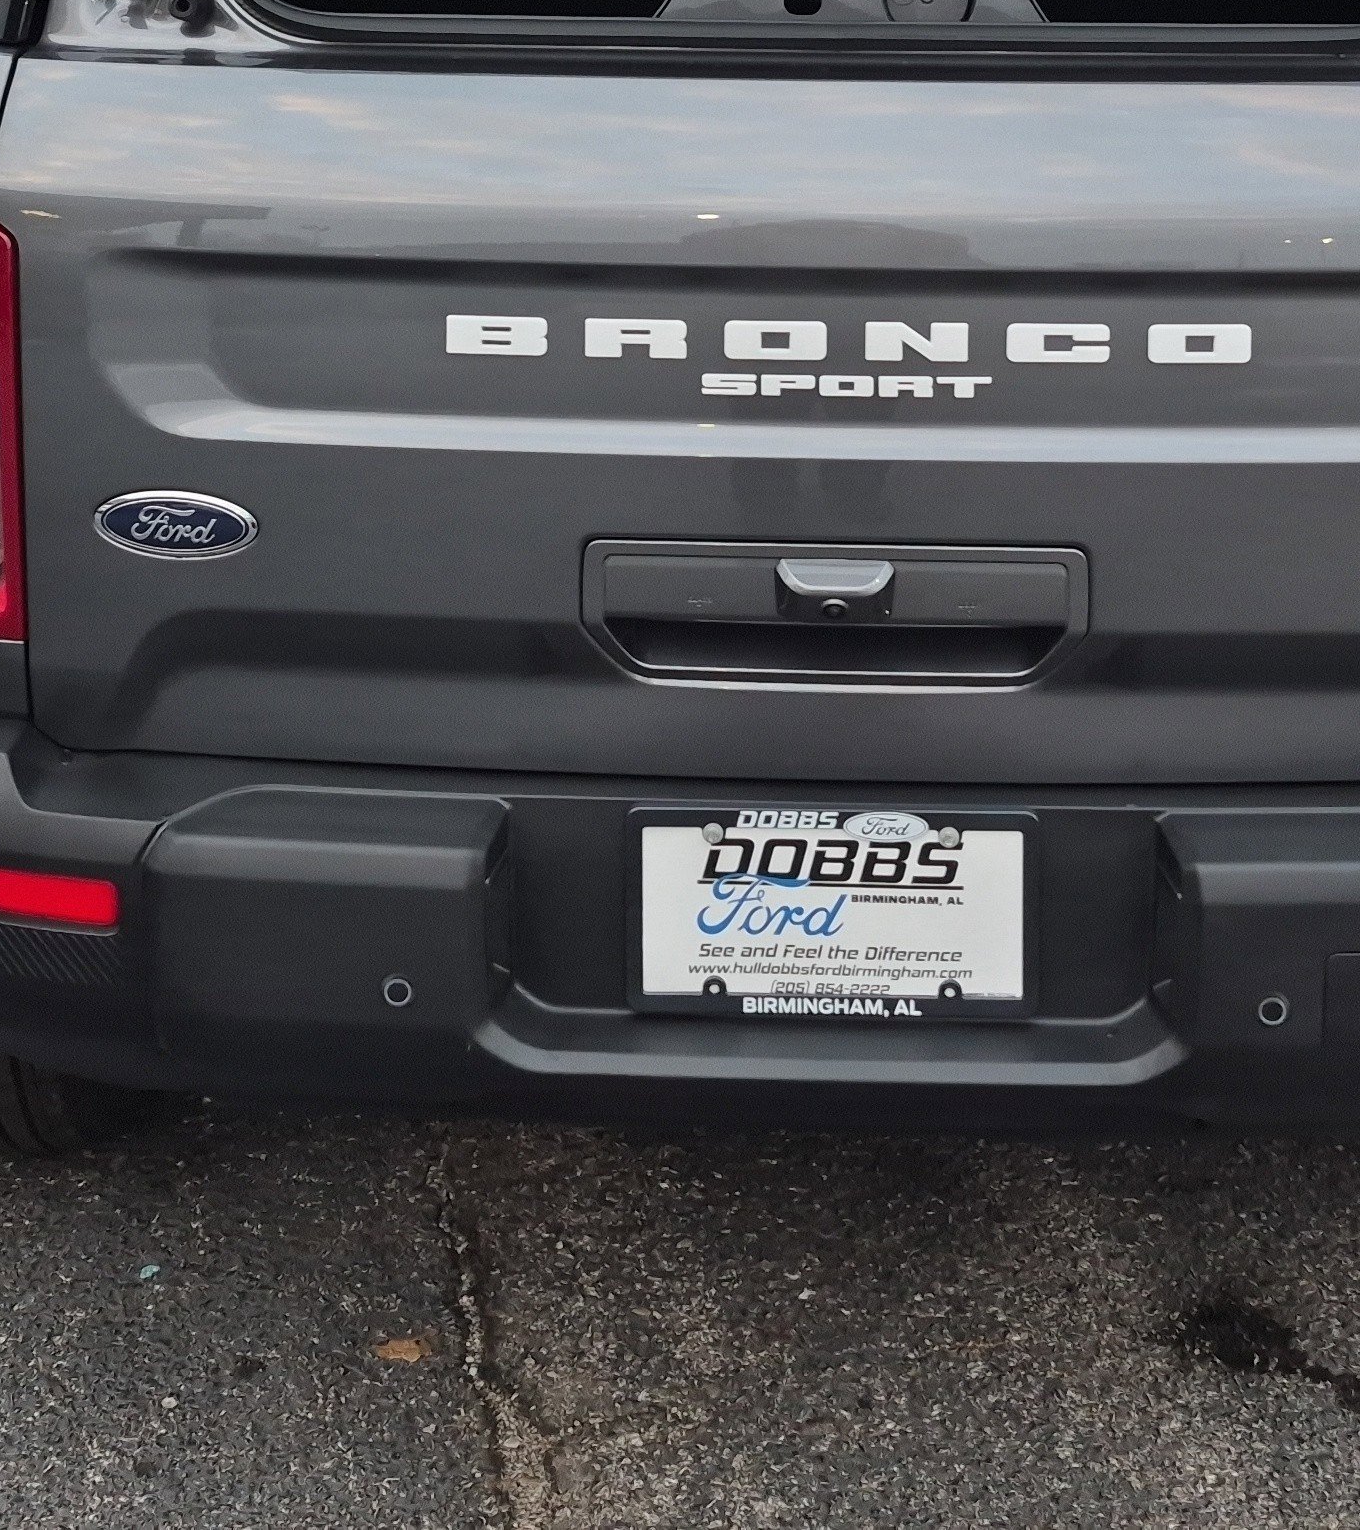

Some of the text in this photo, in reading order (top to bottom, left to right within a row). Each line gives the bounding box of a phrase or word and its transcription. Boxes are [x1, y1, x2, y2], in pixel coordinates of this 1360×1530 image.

[445, 313, 1253, 365] BRONCO
[700, 372, 993, 399] SPORT
[130, 505, 216, 544] Ford
[736, 810, 910, 836] DOBBS Ford
[703, 838, 964, 884] DOBBS
[697, 873, 848, 937] Ford
[851, 894, 964, 906] BIRMINGHAM, AL
[698, 943, 963, 962] See and Feel the Difference
[688, 961, 973, 981] www.hulldobbsfordbirmingham.com
[771, 979, 890, 996] (205) 854-2222
[742, 996, 923, 1018] BIRMINGHAM, AL
